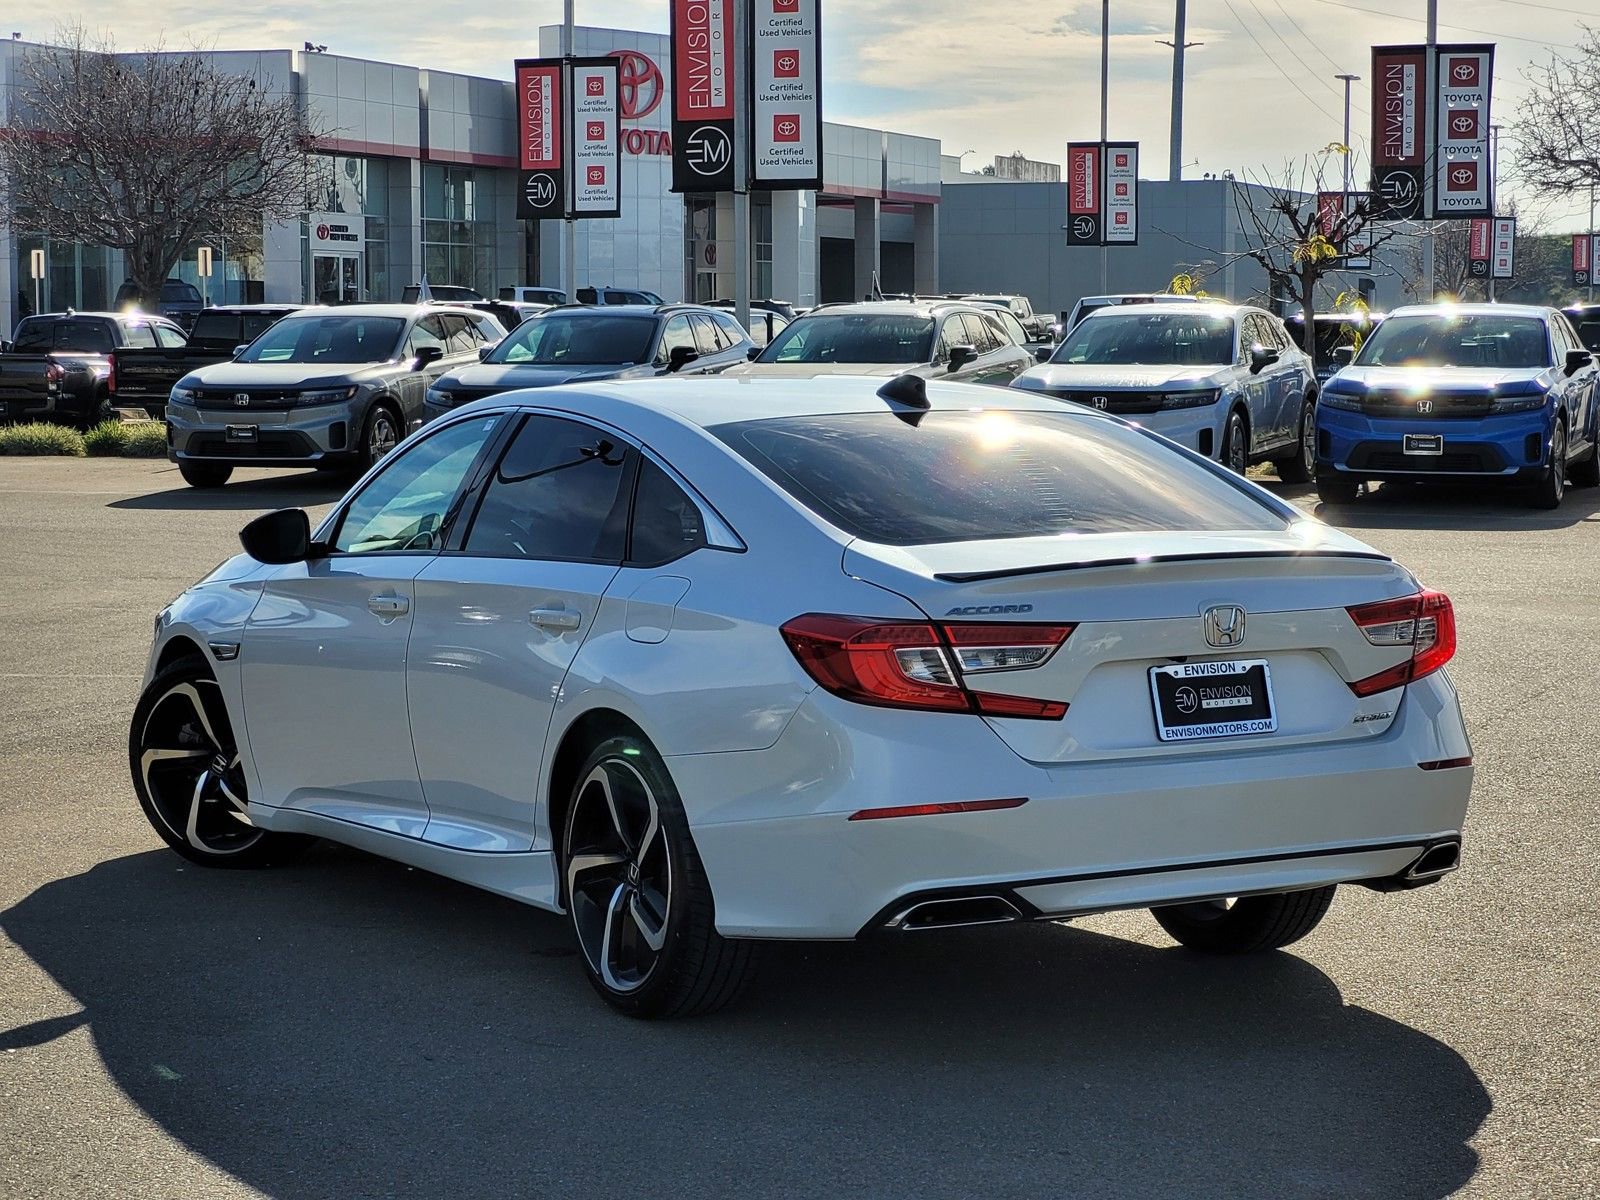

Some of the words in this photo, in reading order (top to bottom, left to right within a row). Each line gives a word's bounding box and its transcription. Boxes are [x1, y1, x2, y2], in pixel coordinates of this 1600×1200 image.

[781, 28, 812, 36] Vehicles
[687, 0, 709, 108] ENVISIO
[712, 0, 723, 96] MOTOR
[759, 94, 780, 102] Used
[782, 93, 813, 101] Vehicles
[1444, 94, 1483, 102] TOYOTA
[1385, 64, 1402, 157] ENVISION
[527, 76, 542, 161] ENVISION
[769, 148, 804, 156] Certified
[1443, 146, 1482, 154] TOYOTA
[759, 158, 781, 166] Used
[782, 157, 814, 166] Vehicles
[1075, 152, 1086, 208] ENVISION
[1443, 198, 1482, 206] TOYOTA
[944, 604, 1033, 616] ACCORD
[1184, 663, 1236, 676] ENVISION
[1200, 685, 1252, 700] ENVISION
[1205, 698, 1249, 707] MOTORS
[1165, 721, 1273, 739] ENVISIONMOTORS.COM
